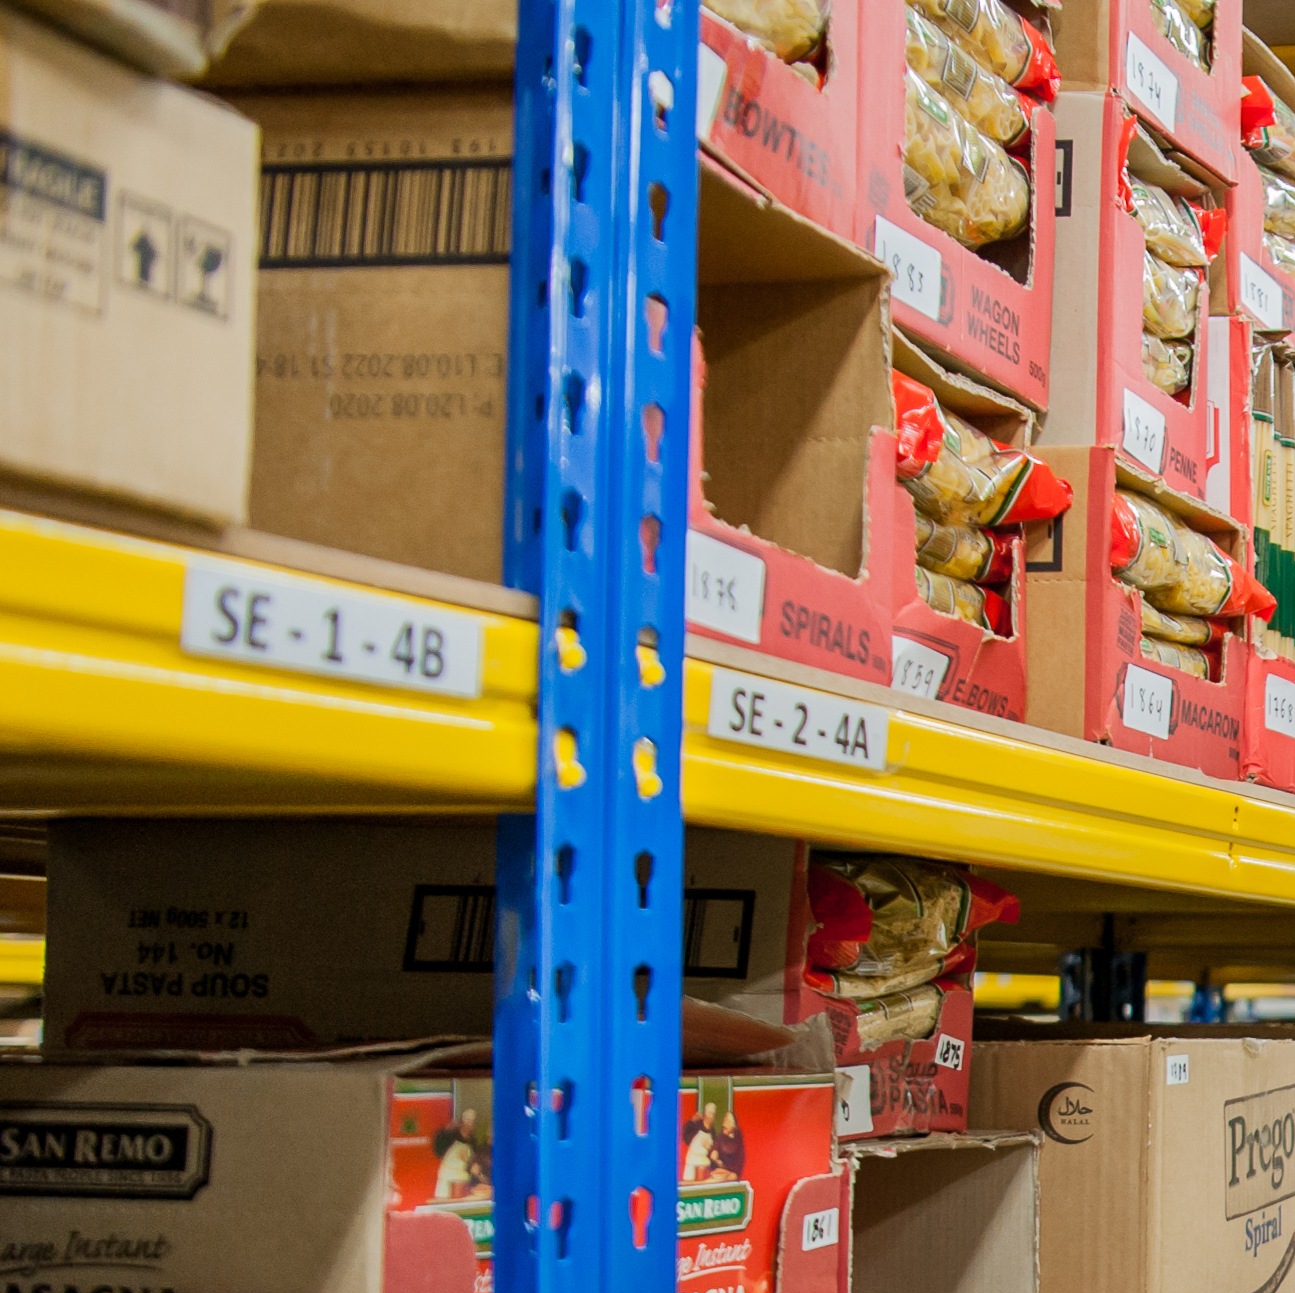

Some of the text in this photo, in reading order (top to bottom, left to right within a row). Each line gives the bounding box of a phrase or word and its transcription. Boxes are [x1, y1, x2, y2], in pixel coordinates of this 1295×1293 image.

[724, 87, 829, 187] BOWTIES
[971, 284, 1020, 336] WAGON
[967, 314, 1021, 365] WHEELS
[1128, 408, 1155, 453] 1870
[1169, 445, 1198, 482] PENNE
[1285, 461, 1294, 540] SPAGHETTI
[211, 584, 272, 652] SE
[392, 622, 445, 679] 4B
[780, 600, 871, 666] SPIRALS
[728, 687, 764, 737] SE
[834, 712, 869, 760] 4A
[1130, 690, 1163, 722] 1864
[101, 973, 270, 999] PASTA SOUP
[1060, 1118, 1092, 1126] HALAL
[73, 1132, 173, 1164] REMO
[703, 1197, 741, 1220] REMO
[698, 1238, 753, 1266] Instant
[1245, 1205, 1282, 1258] Spiral
[0, 1237, 57, 1276] arge
